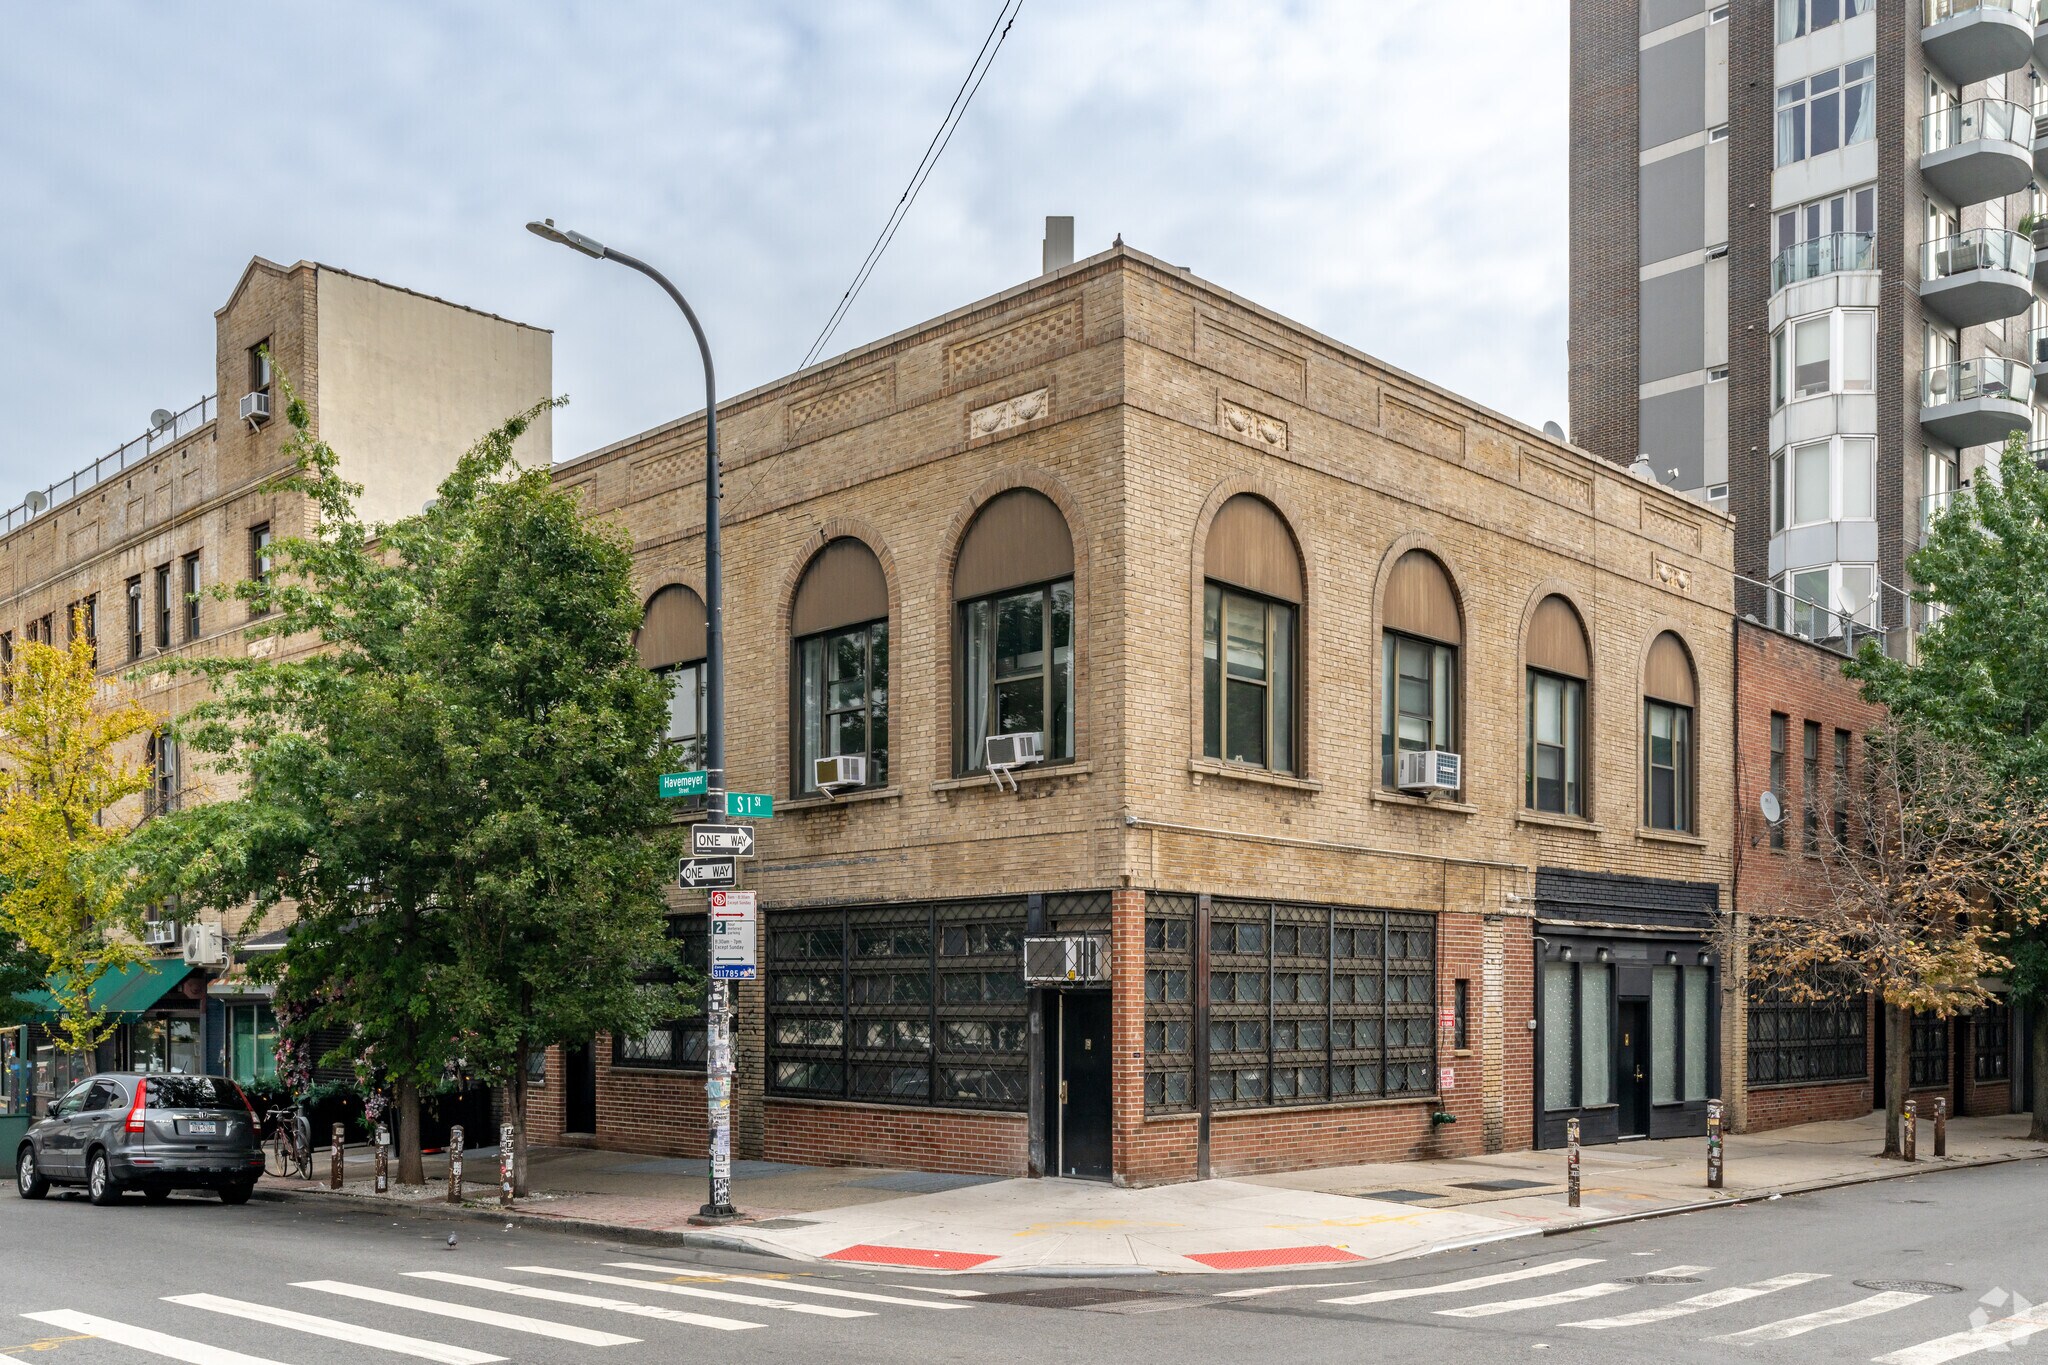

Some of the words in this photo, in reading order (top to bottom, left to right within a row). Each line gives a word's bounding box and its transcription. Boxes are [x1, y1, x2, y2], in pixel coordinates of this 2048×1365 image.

[664, 775, 703, 788] Havemeyer
[737, 796, 743, 813] S
[747, 797, 751, 813] 1
[699, 834, 721, 846] ONE
[730, 835, 748, 847] WAY
[685, 867, 703, 879] ONE
[713, 865, 730, 877] WAY
[716, 922, 723, 933] 2
[714, 969, 739, 978] 311785
